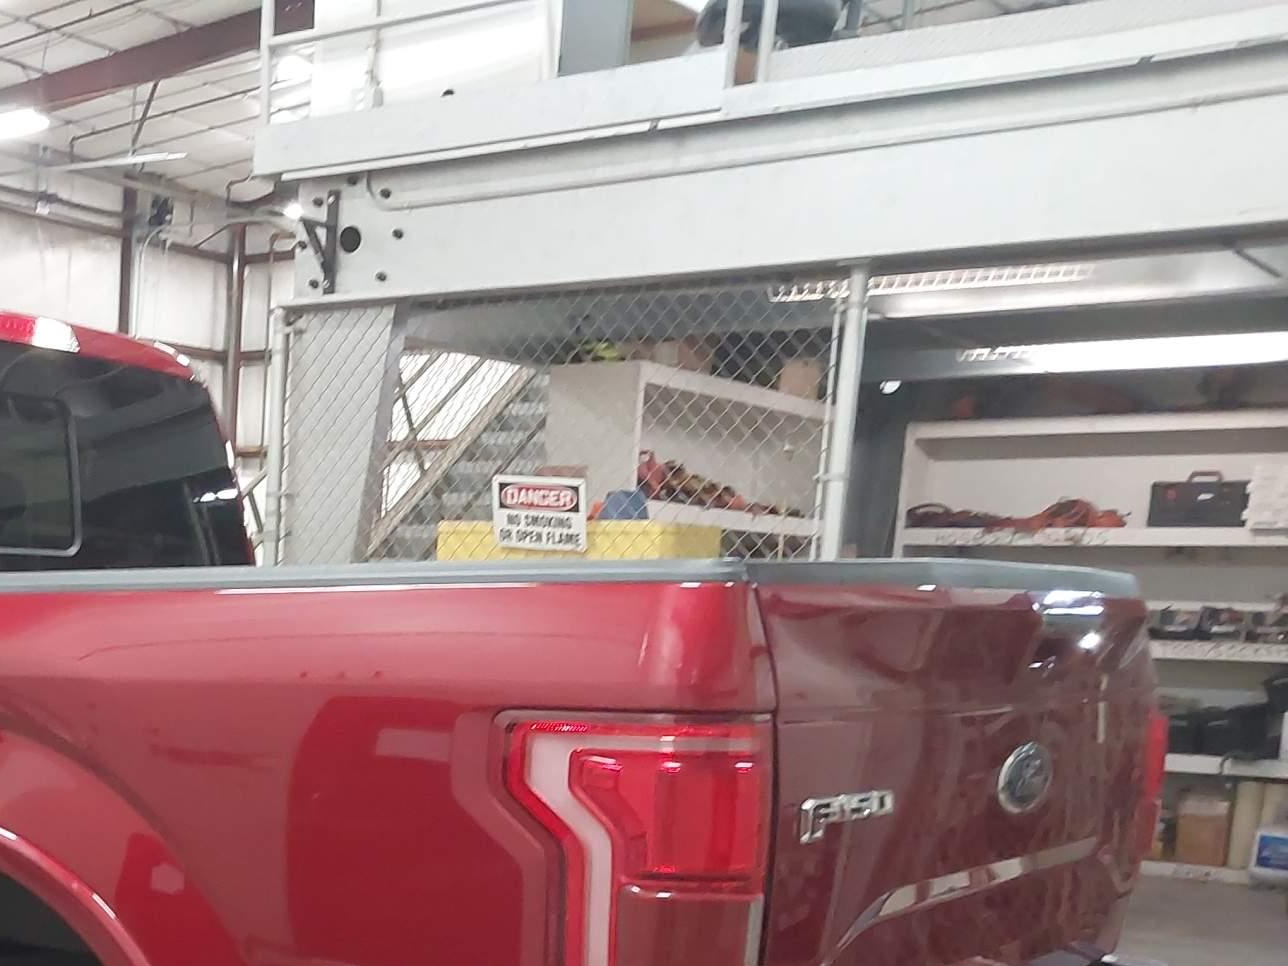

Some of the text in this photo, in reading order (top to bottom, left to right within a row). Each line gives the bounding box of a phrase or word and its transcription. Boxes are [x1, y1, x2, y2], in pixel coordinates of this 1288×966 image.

[506, 487, 573, 507] DANGER
[506, 513, 572, 529] NO SMOKING
[499, 528, 582, 548] OR OPEN FLAME
